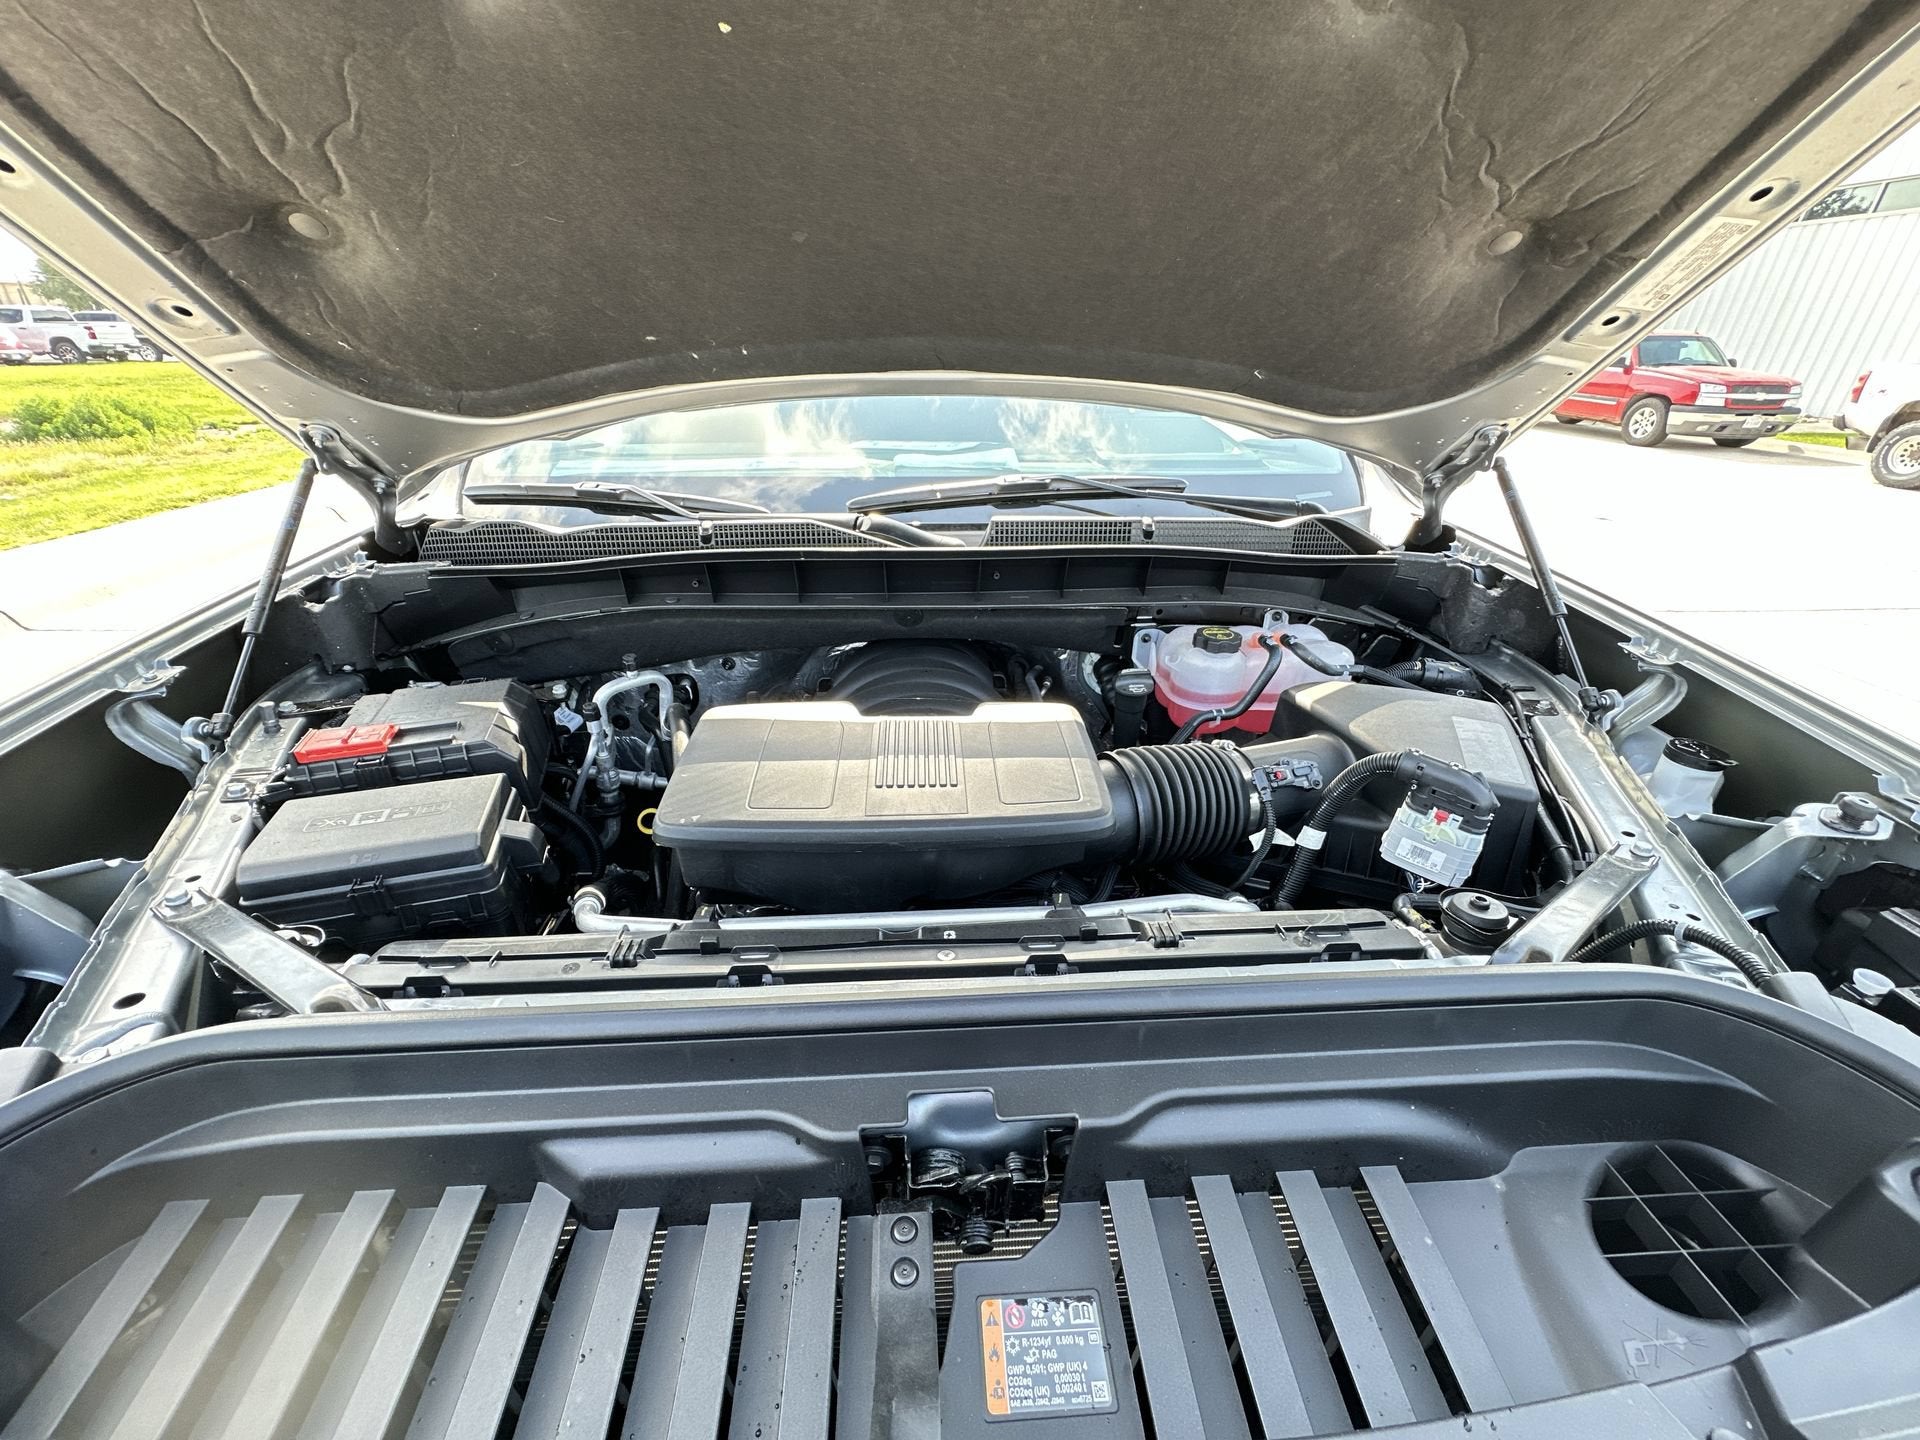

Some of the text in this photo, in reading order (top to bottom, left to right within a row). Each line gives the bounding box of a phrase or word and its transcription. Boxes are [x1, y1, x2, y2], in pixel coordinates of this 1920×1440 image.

[1031, 1318, 1048, 1327] AUTO
[1075, 1334, 1084, 1346] kg
[1041, 1349, 1057, 1359] PAG
[1007, 1365, 1025, 1375] GWP
[1047, 1363, 1065, 1373] GWP
[1066, 1361, 1082, 1373] (UK)
[1082, 1361, 1088, 1370] 4
[1008, 1377, 1032, 1387] CO2eq
[1009, 1387, 1033, 1398] CO2eq
[1034, 1385, 1050, 1398] (UK)
